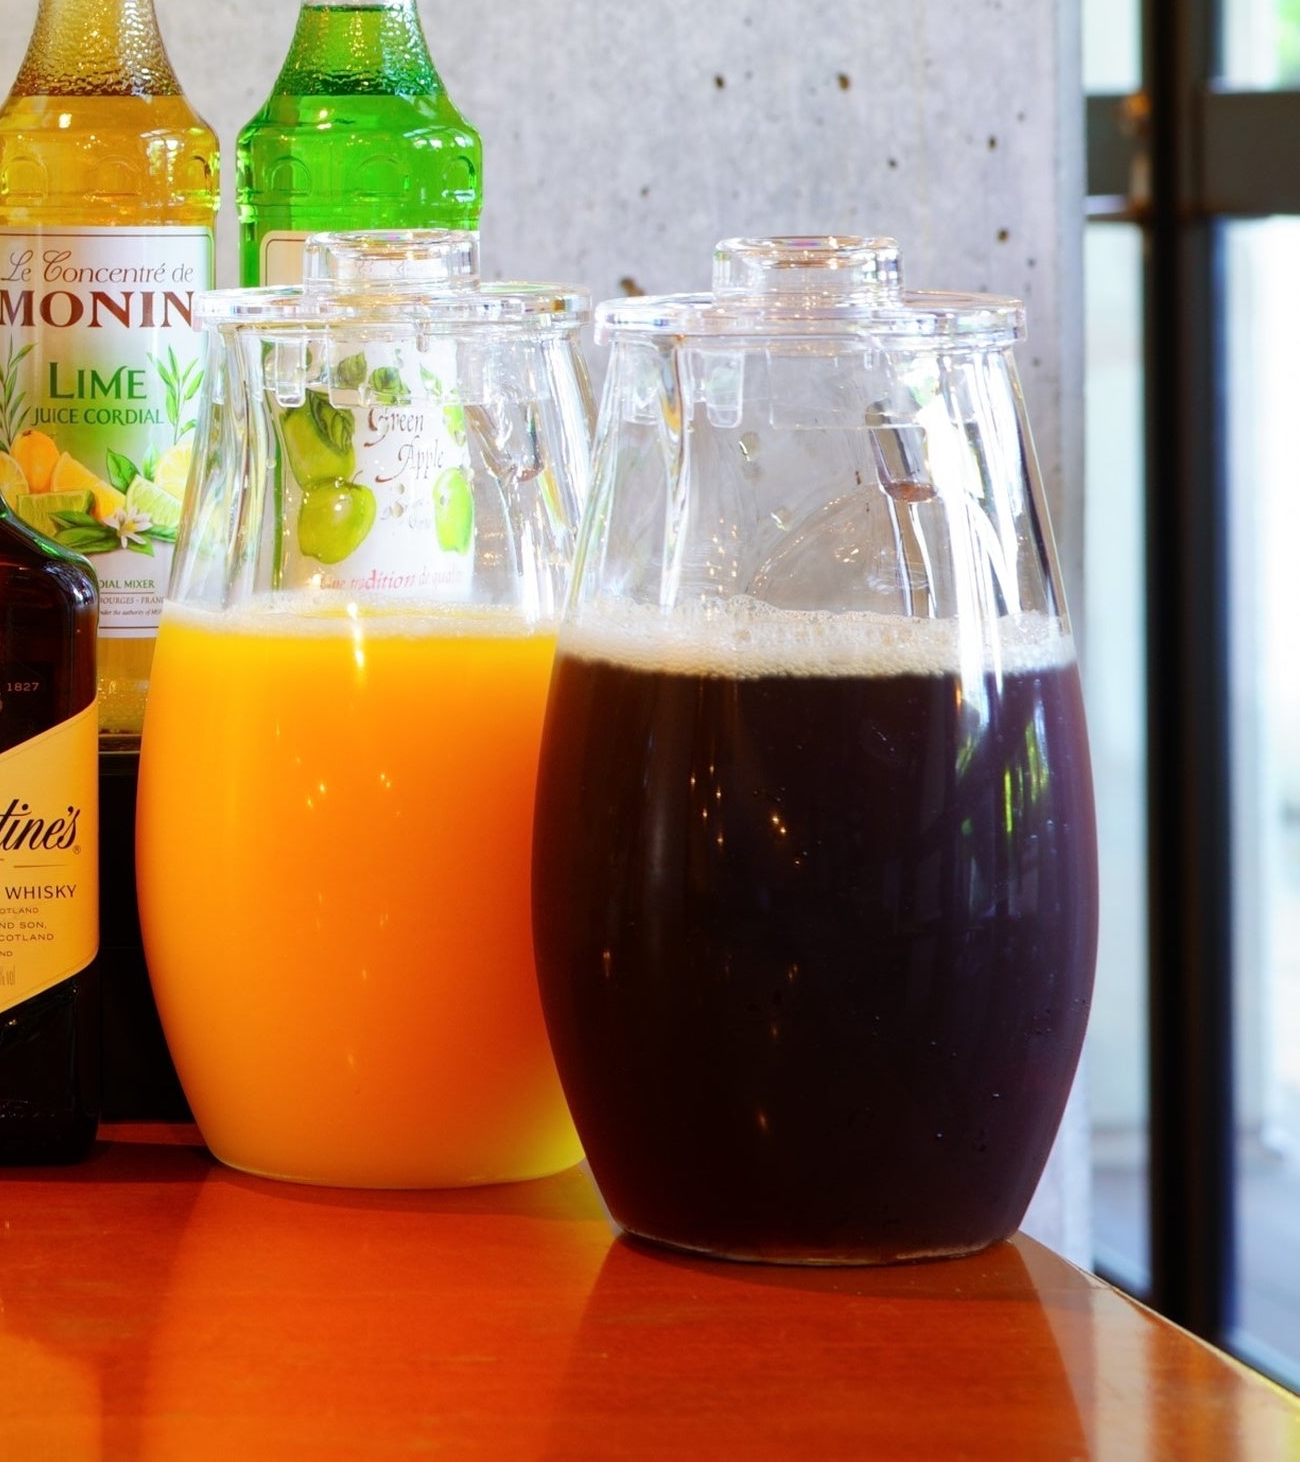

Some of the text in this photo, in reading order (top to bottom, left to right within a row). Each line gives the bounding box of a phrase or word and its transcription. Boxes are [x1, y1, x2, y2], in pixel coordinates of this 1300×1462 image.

[0, 249, 194, 283] Le Concentré de
[48, 361, 147, 400] LIME
[31, 407, 165, 426] JUICE CORDIAL
[99, 579, 155, 589] DIAL MIXER
[7, 681, 40, 692] 1827
[4, 884, 77, 899] WHISKY
